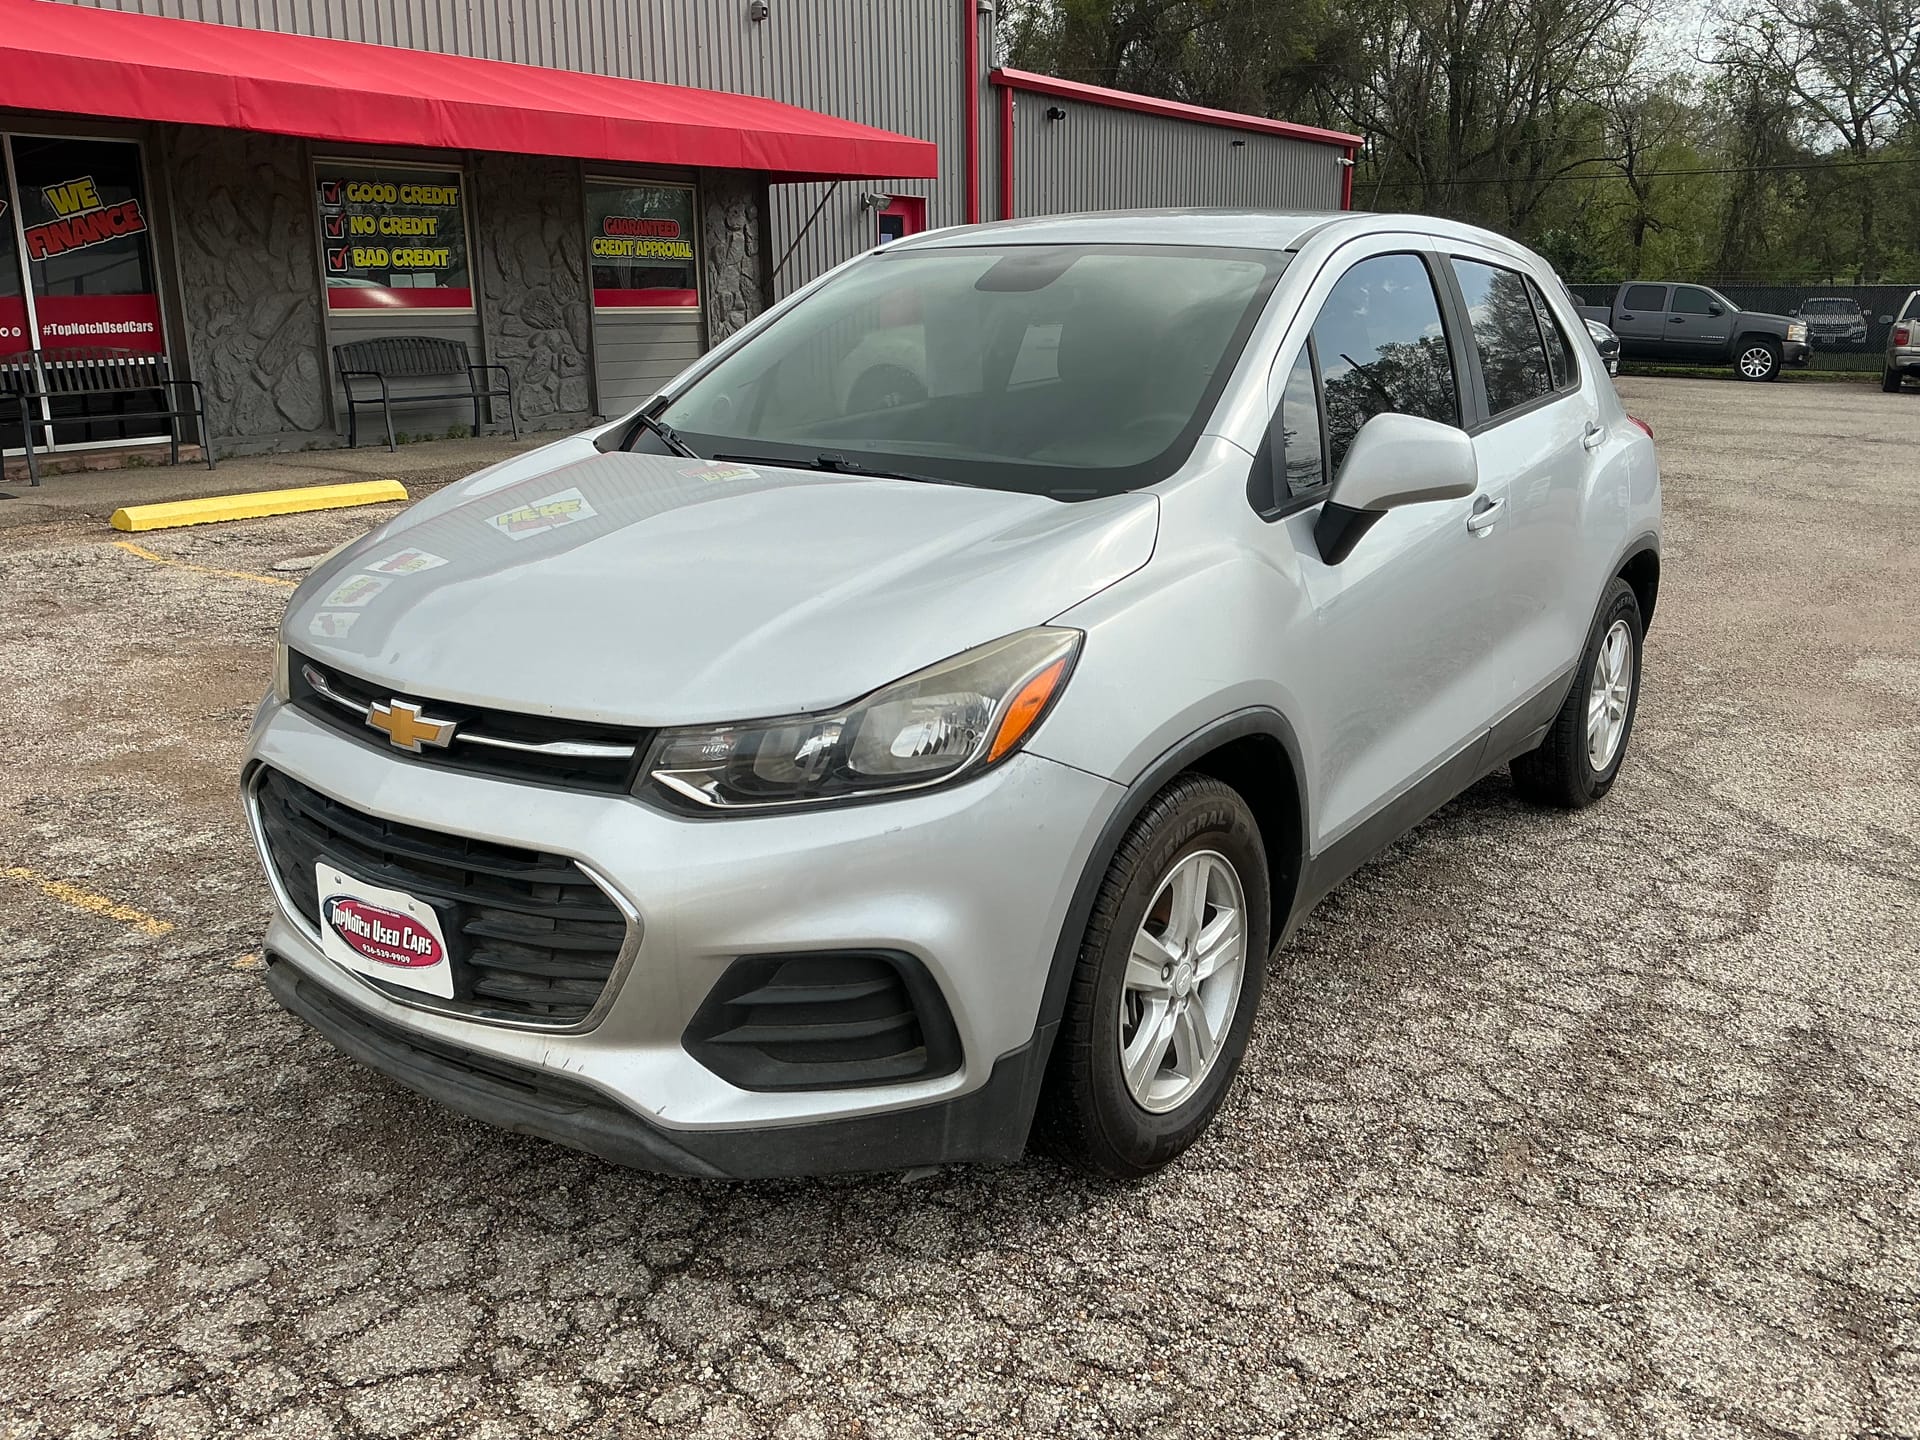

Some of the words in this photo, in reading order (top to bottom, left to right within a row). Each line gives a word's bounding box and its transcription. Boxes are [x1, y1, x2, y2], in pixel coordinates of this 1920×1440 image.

[46, 178, 100, 216] WE
[347, 183, 398, 203] GOOD
[400, 186, 458, 205] CREDIT
[25, 201, 145, 260] FINANCE
[350, 216, 376, 235] NO
[379, 216, 438, 236] CREDIT
[605, 218, 679, 238] GUARANTEED
[352, 248, 389, 267] BAD
[391, 249, 449, 268] CREDIT
[592, 239, 634, 256] CREDIT
[635, 240, 693, 258] APPROVAL
[43, 321, 154, 336] #TopNotchUsedCars
